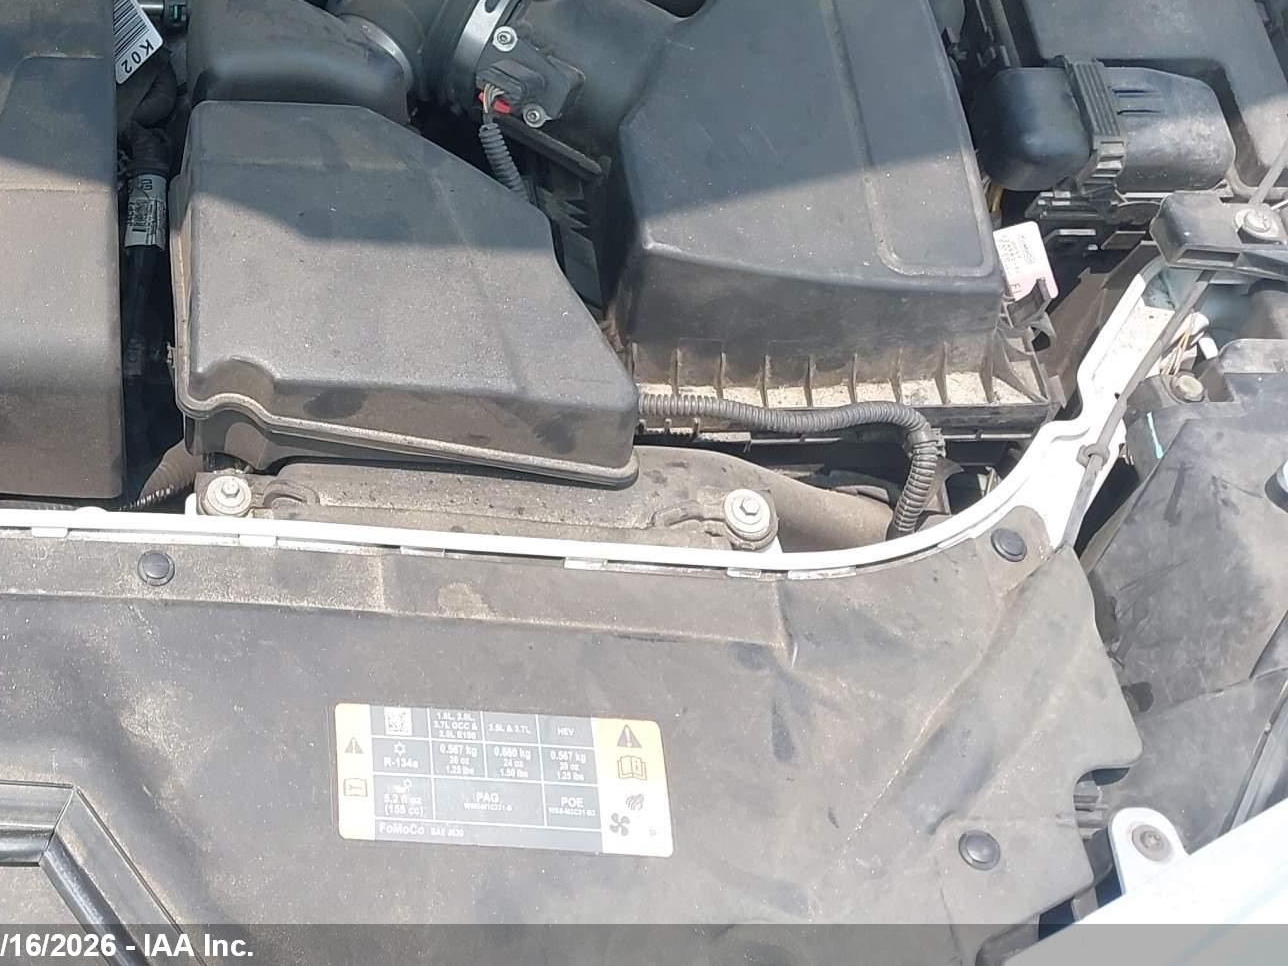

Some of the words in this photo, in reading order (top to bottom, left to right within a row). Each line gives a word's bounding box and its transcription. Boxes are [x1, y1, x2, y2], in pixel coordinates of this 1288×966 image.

[120, 38, 154, 75] K02
[466, 745, 477, 757] kg
[519, 747, 531, 760] kg
[575, 751, 587, 764] kg
[383, 756, 419, 770] R-134a
[476, 791, 499, 803] PAG
[560, 796, 584, 808] POE
[379, 822, 425, 835] FoMoCo
